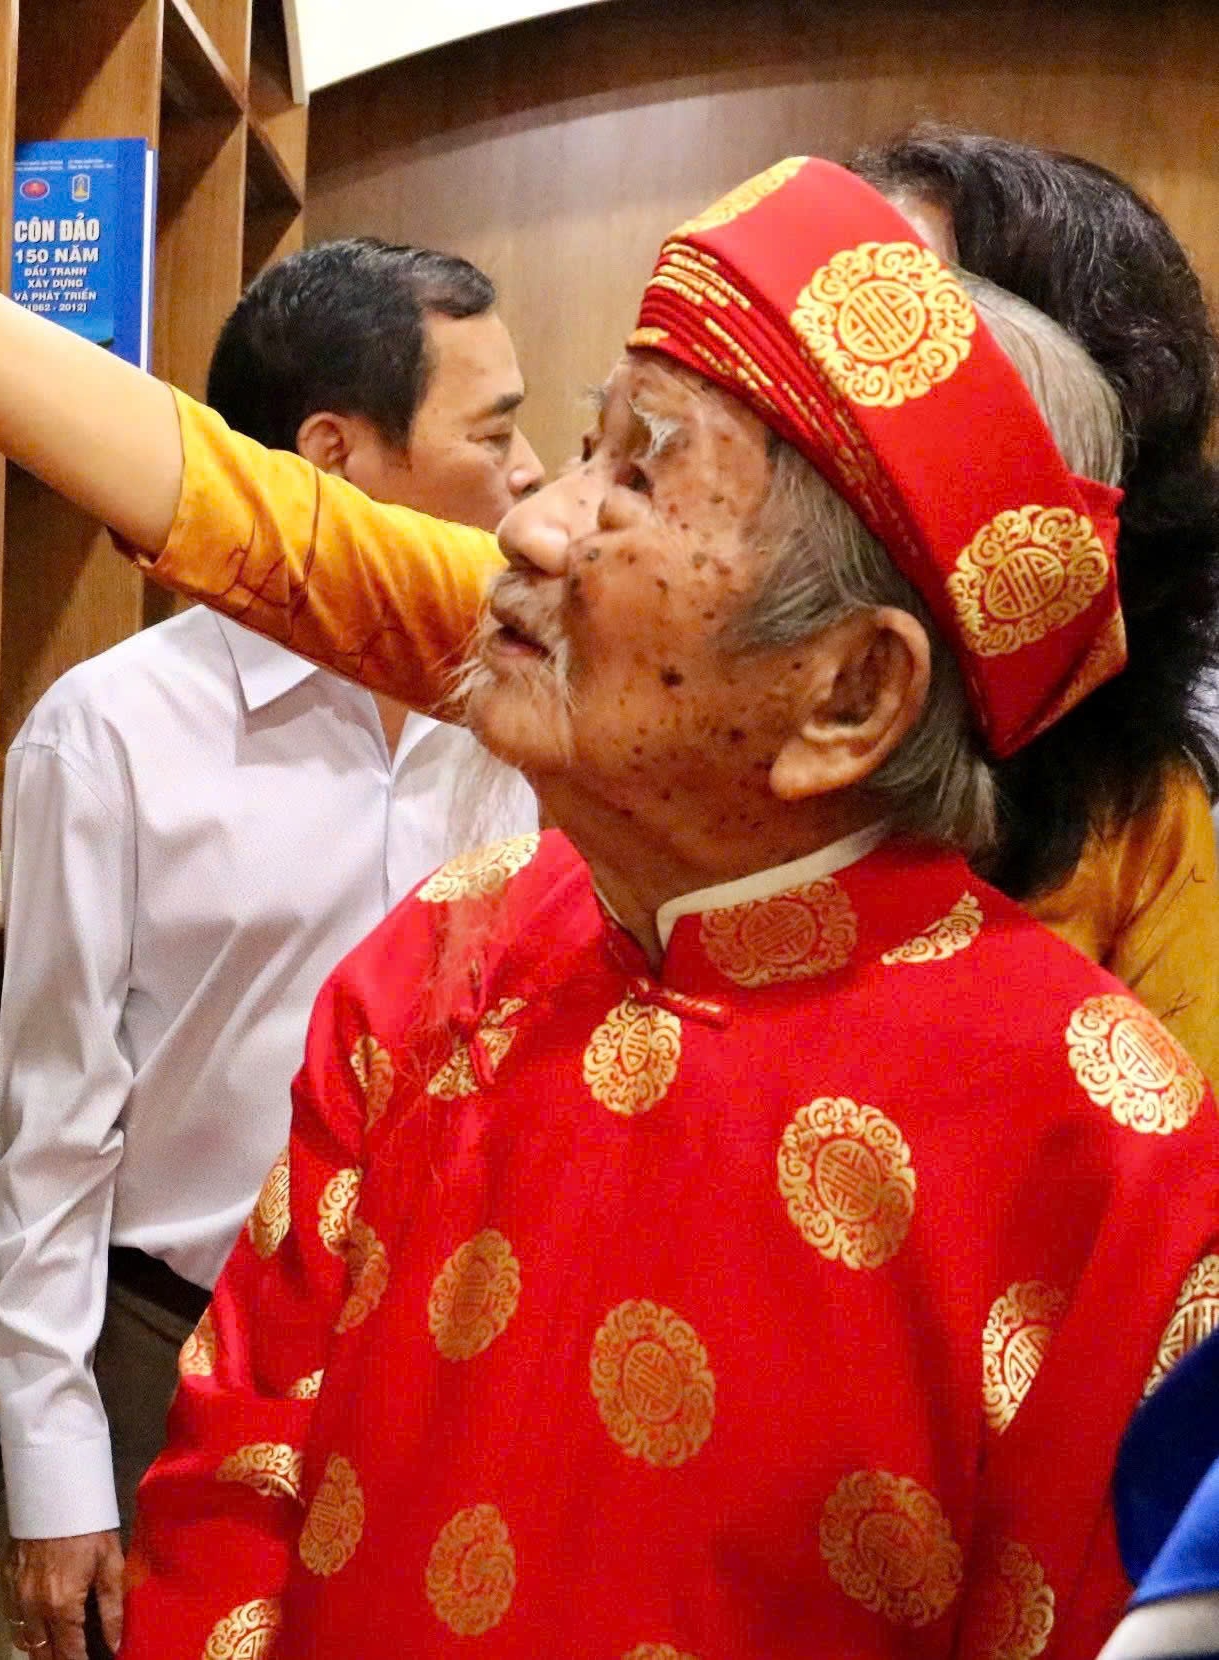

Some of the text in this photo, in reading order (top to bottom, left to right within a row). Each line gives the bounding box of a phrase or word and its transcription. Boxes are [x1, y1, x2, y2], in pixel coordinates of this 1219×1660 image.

[14, 212, 101, 243] CÔN ĐẢO
[15, 245, 99, 264] 150 NĂM
[24, 264, 87, 276] ĐẤU TRANH
[27, 279, 84, 290] XÂY DỰNG
[14, 288, 97, 301] VÀ PHÁT TRIỂN
[58, 302, 88, 313] 2012)
